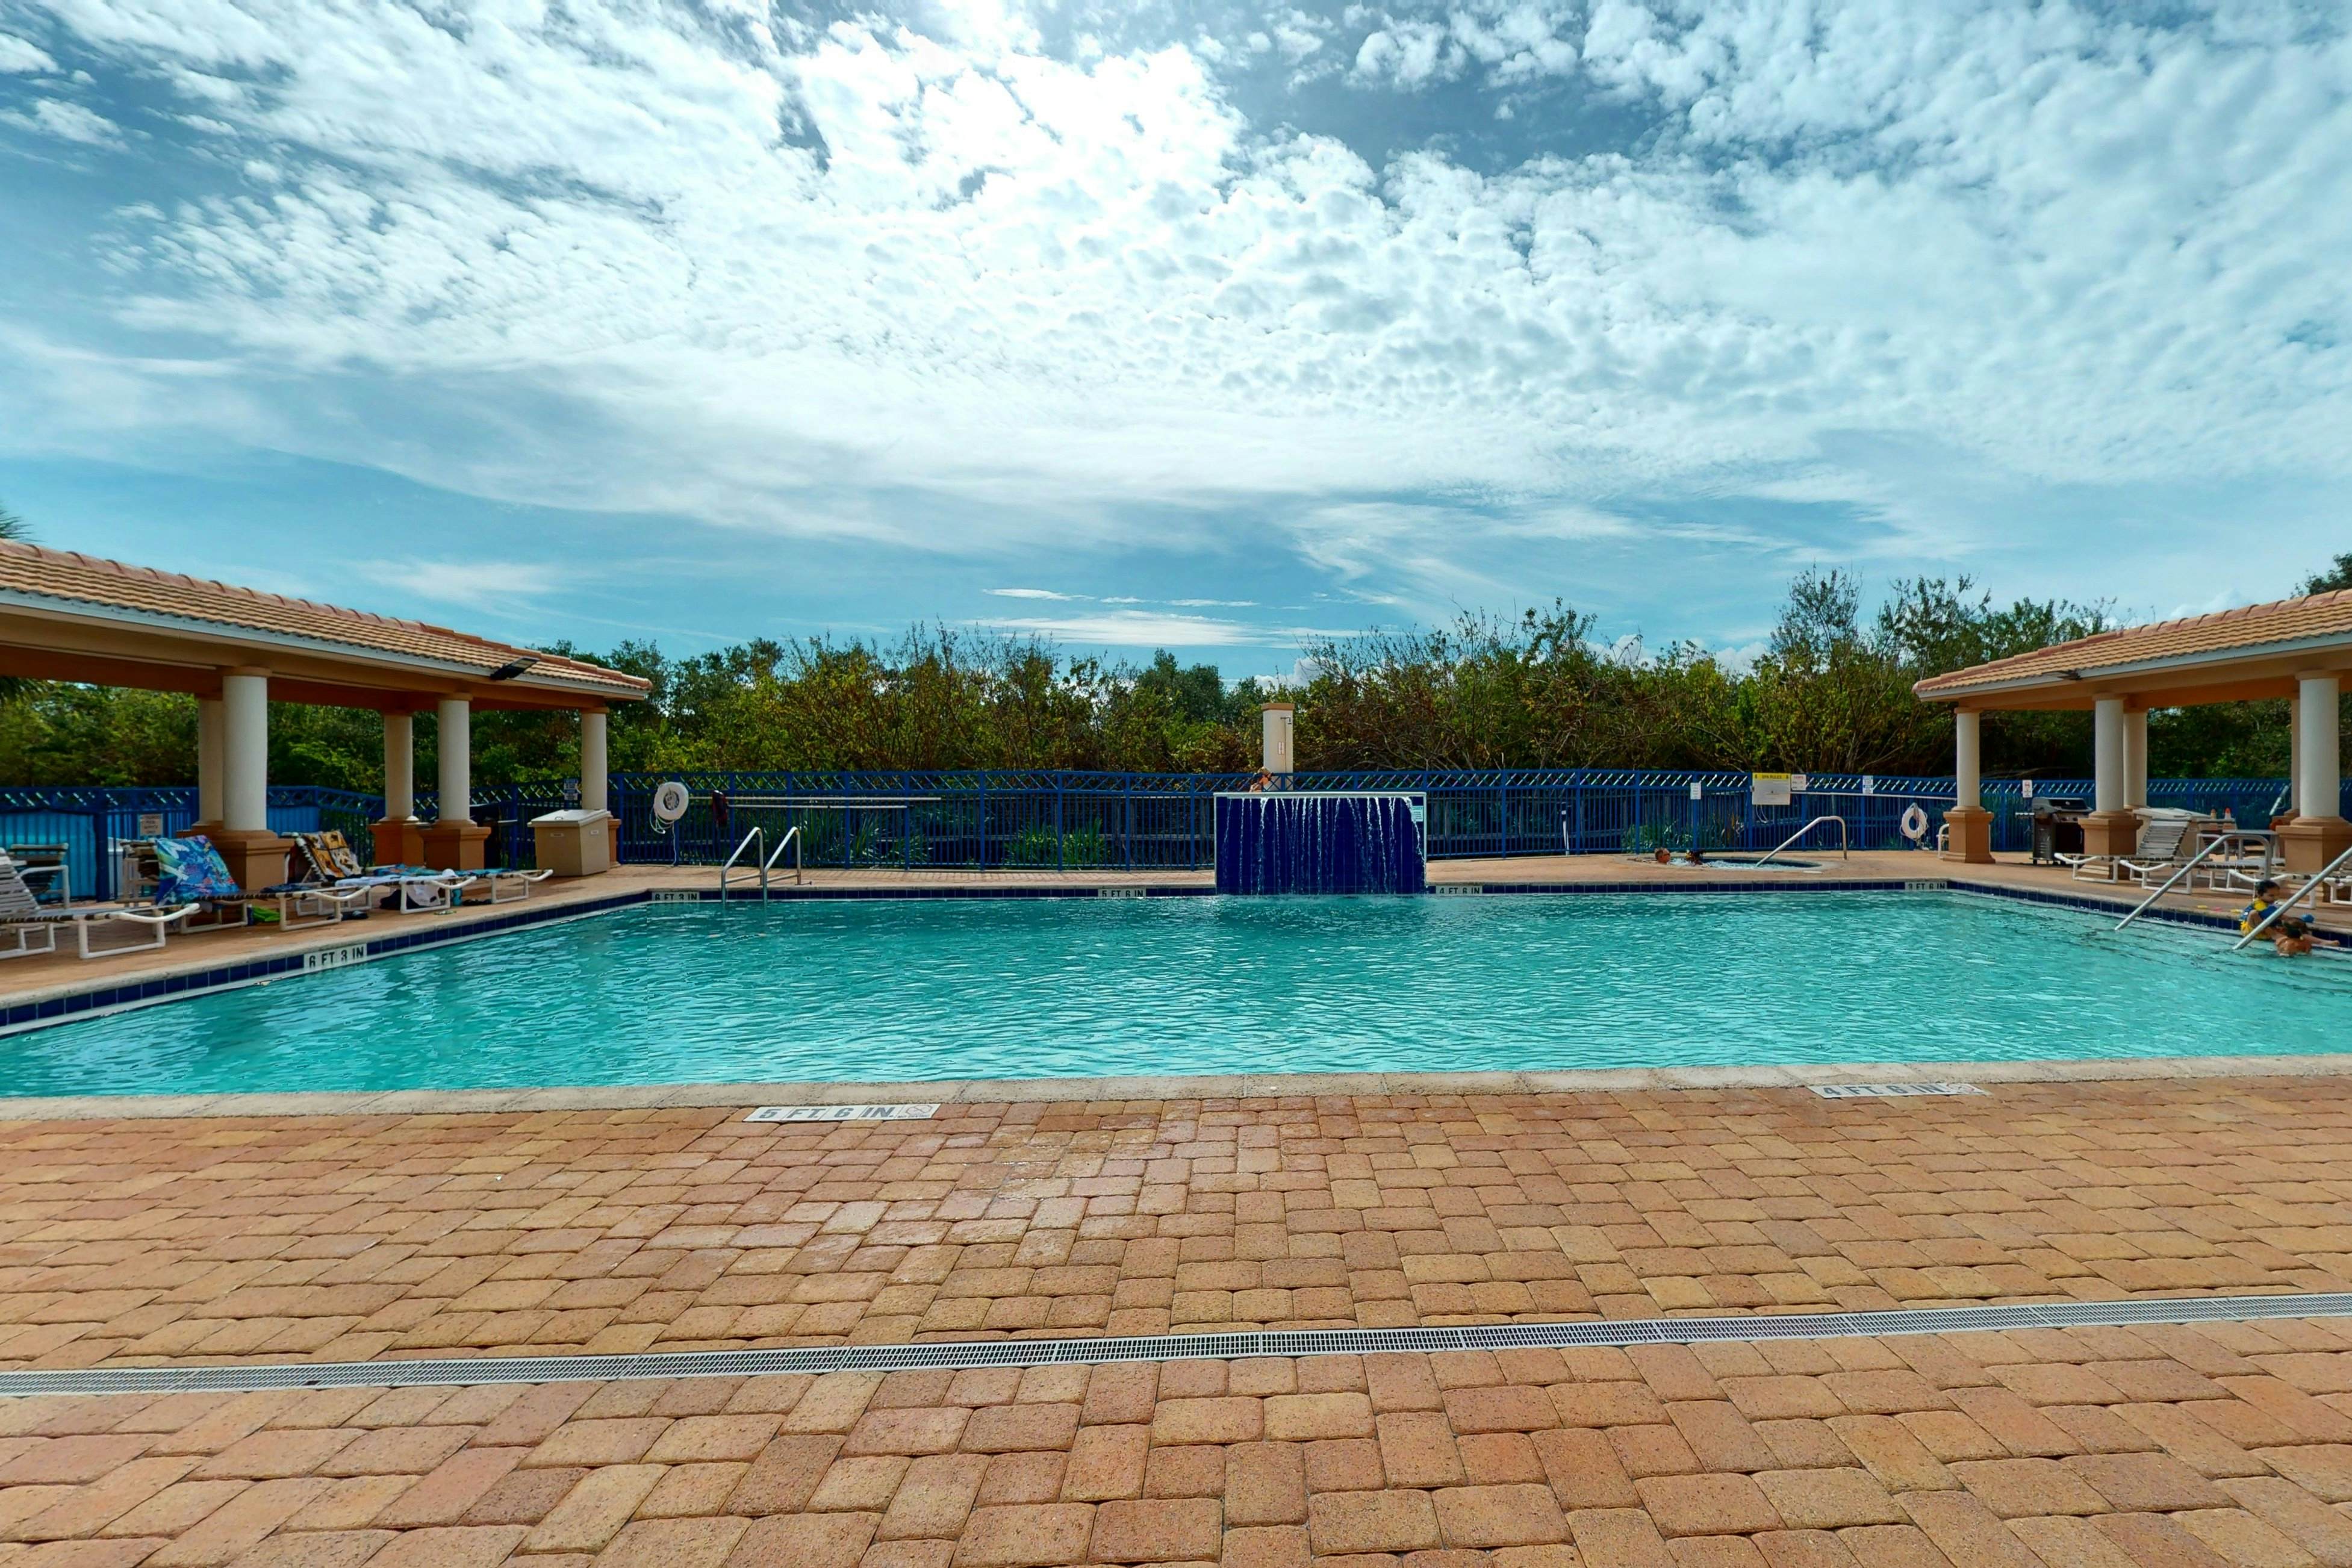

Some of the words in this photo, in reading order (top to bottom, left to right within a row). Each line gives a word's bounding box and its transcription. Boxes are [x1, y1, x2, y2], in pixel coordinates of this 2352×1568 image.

[309, 955, 316, 968] 6
[322, 951, 335, 966] FT
[341, 950, 348, 962] 3
[352, 946, 364, 960] IN
[1886, 1085, 1908, 1094] 6
[759, 1109, 782, 1119] 5
[834, 1107, 854, 1118] 6
[861, 1106, 895, 1118] IN.
